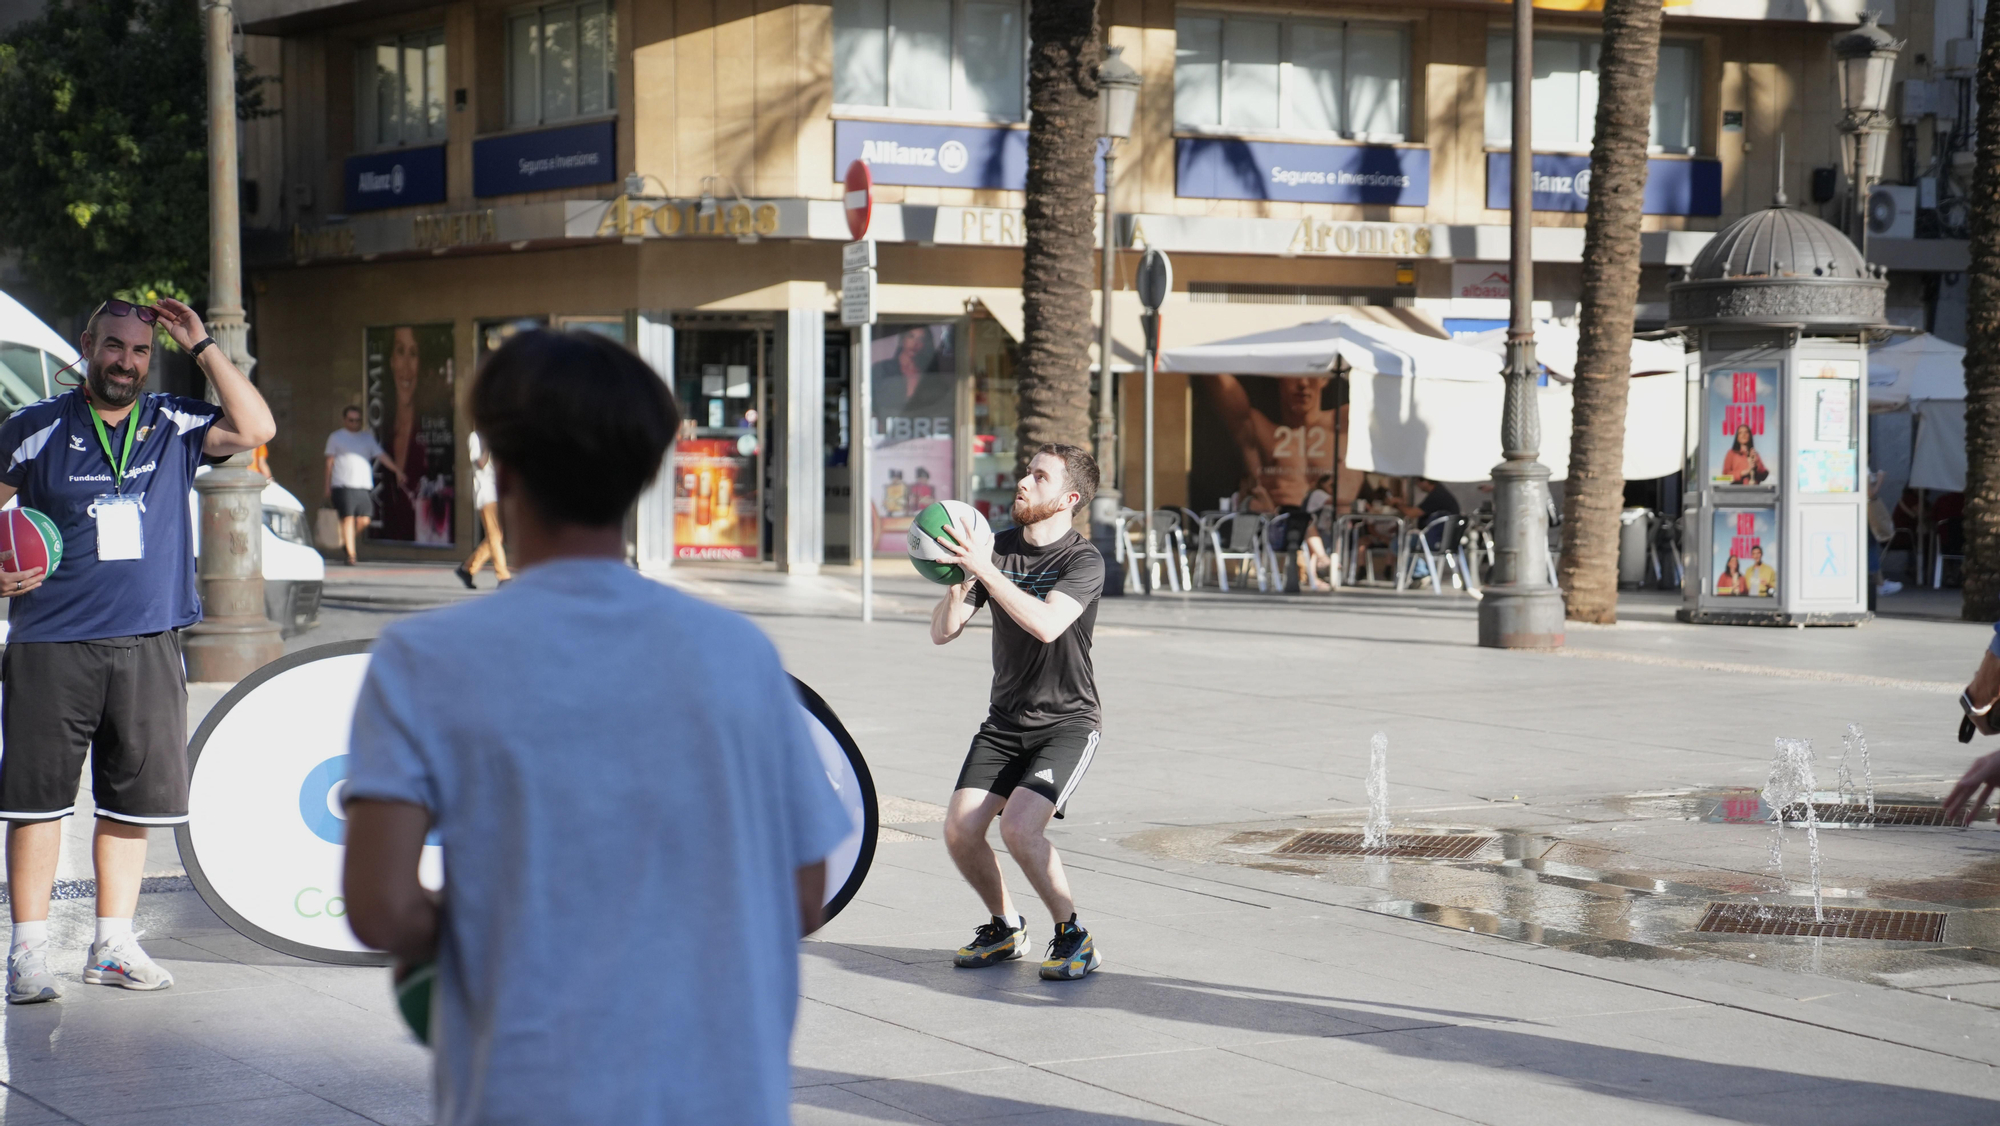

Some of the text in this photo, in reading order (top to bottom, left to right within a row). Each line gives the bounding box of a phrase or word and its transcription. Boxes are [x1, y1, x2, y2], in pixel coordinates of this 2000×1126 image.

[518, 157, 549, 176] Seguros
[555, 150, 599, 168] Inversiones
[861, 140, 937, 167] Allianz
[358, 171, 391, 192] Allianz
[1271, 166, 1410, 188] Seguros e Inversiones
[597, 194, 778, 236] Aromas
[1287, 215, 1431, 254] Aromas
[1732, 372, 1757, 404] BIEN
[871, 417, 949, 439] LIBRE
[1722, 405, 1765, 436] JUGADO
[1273, 425, 1326, 458] 212
[122, 461, 156, 479] Cajasol
[1737, 513, 1755, 535] BIEN
[679, 548, 743, 560] CLARINS
[294, 887, 346, 918] Co
